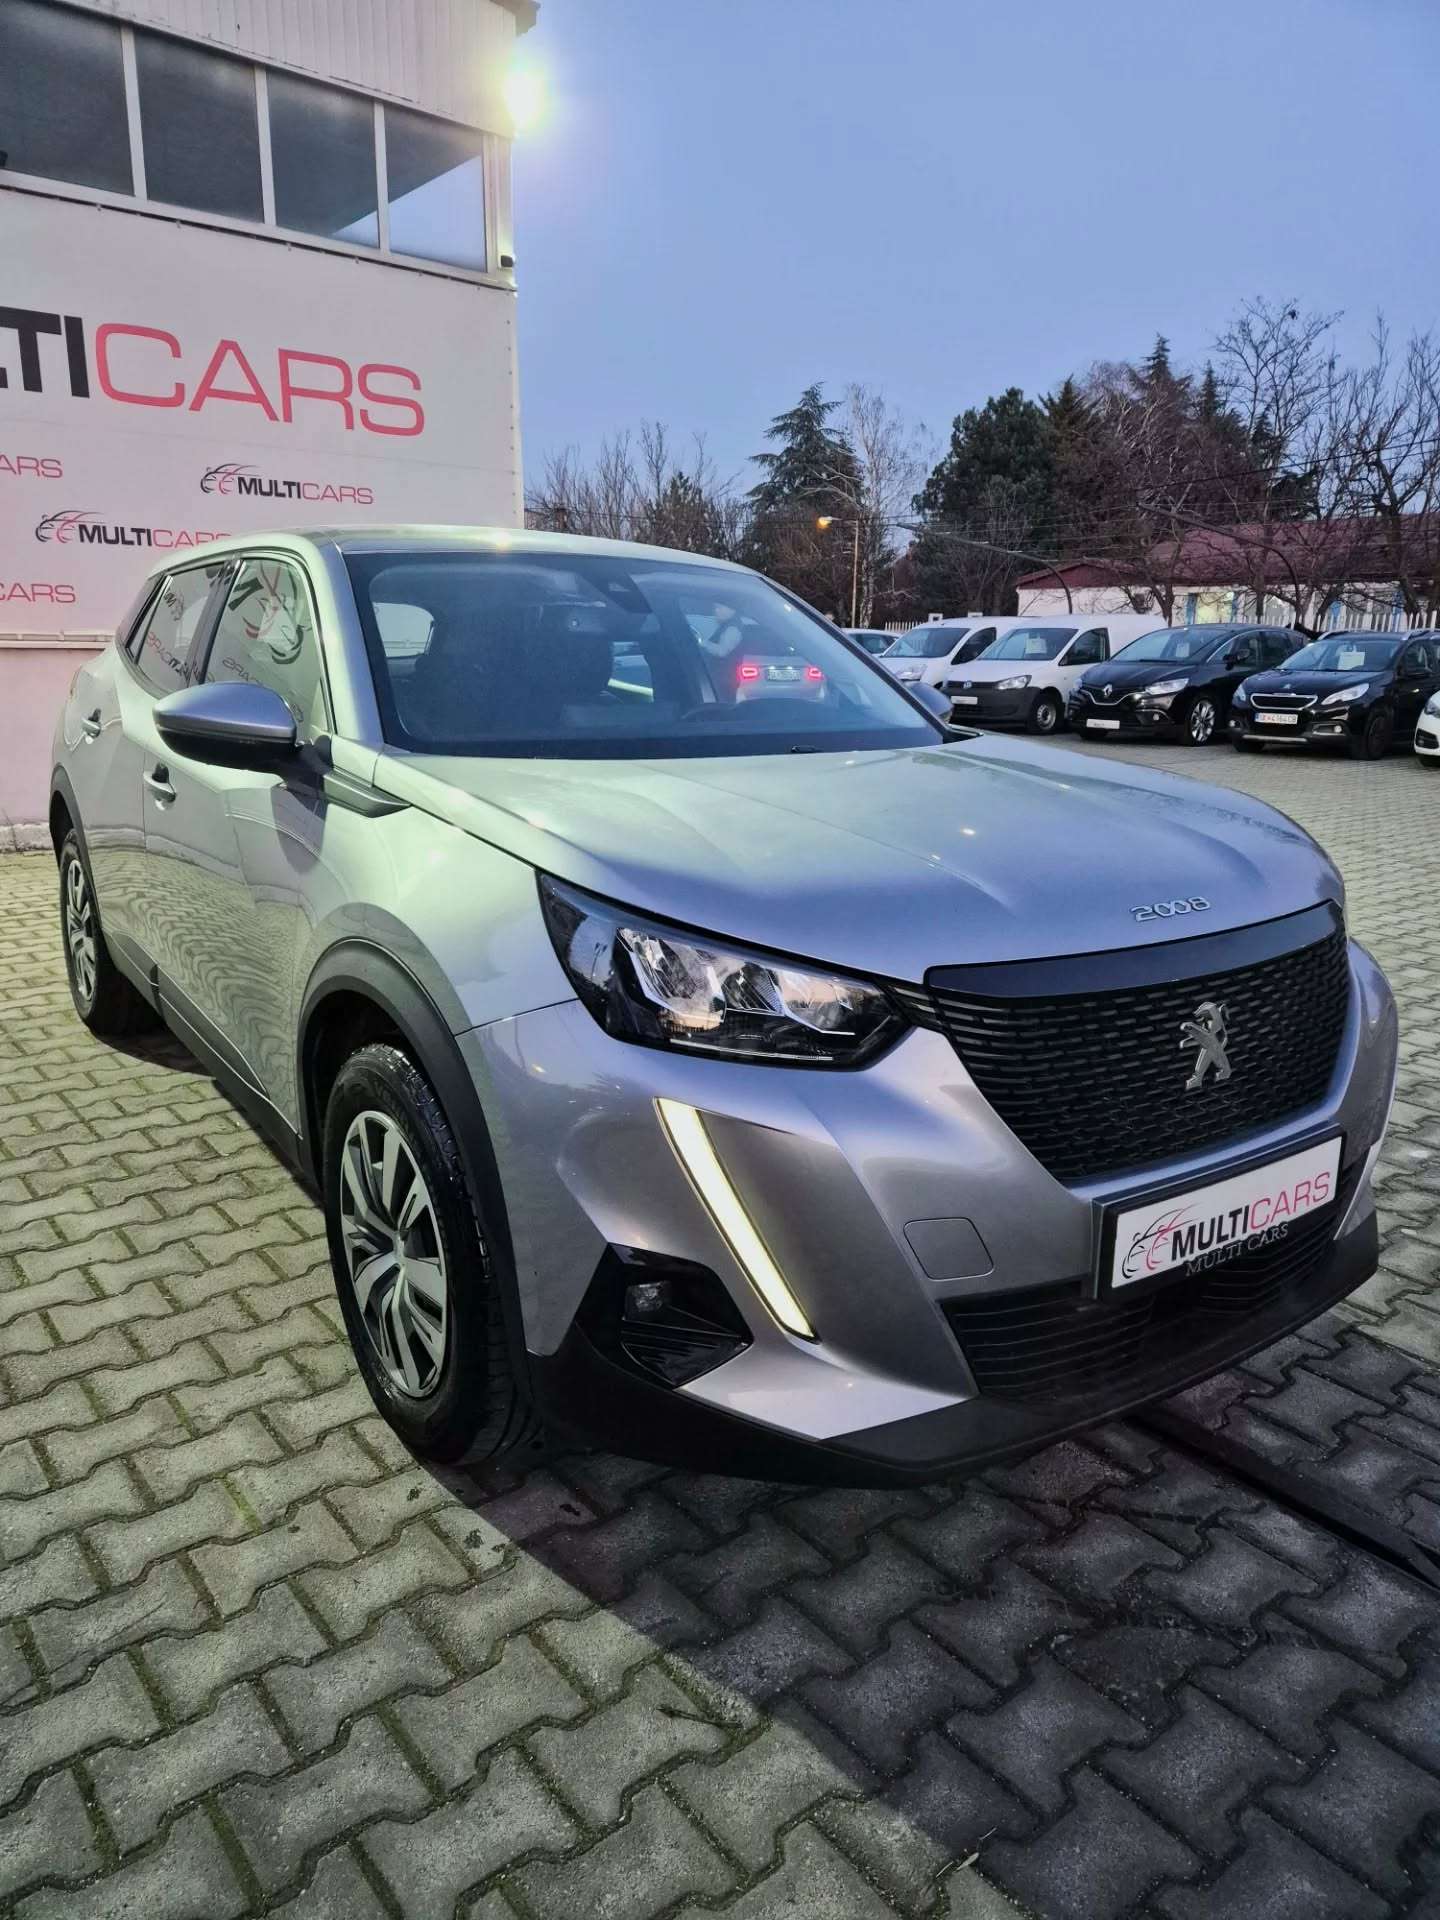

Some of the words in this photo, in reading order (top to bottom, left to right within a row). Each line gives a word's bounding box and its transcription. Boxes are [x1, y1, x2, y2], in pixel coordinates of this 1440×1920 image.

[0, 306, 425, 436] TICARS
[237, 476, 374, 505] MULTICARS
[1131, 896, 1211, 922] 2008
[1170, 1172, 1331, 1262] MULTICARS
[1185, 1242, 1243, 1277] MULTI
[1247, 1221, 1289, 1251] CARS
